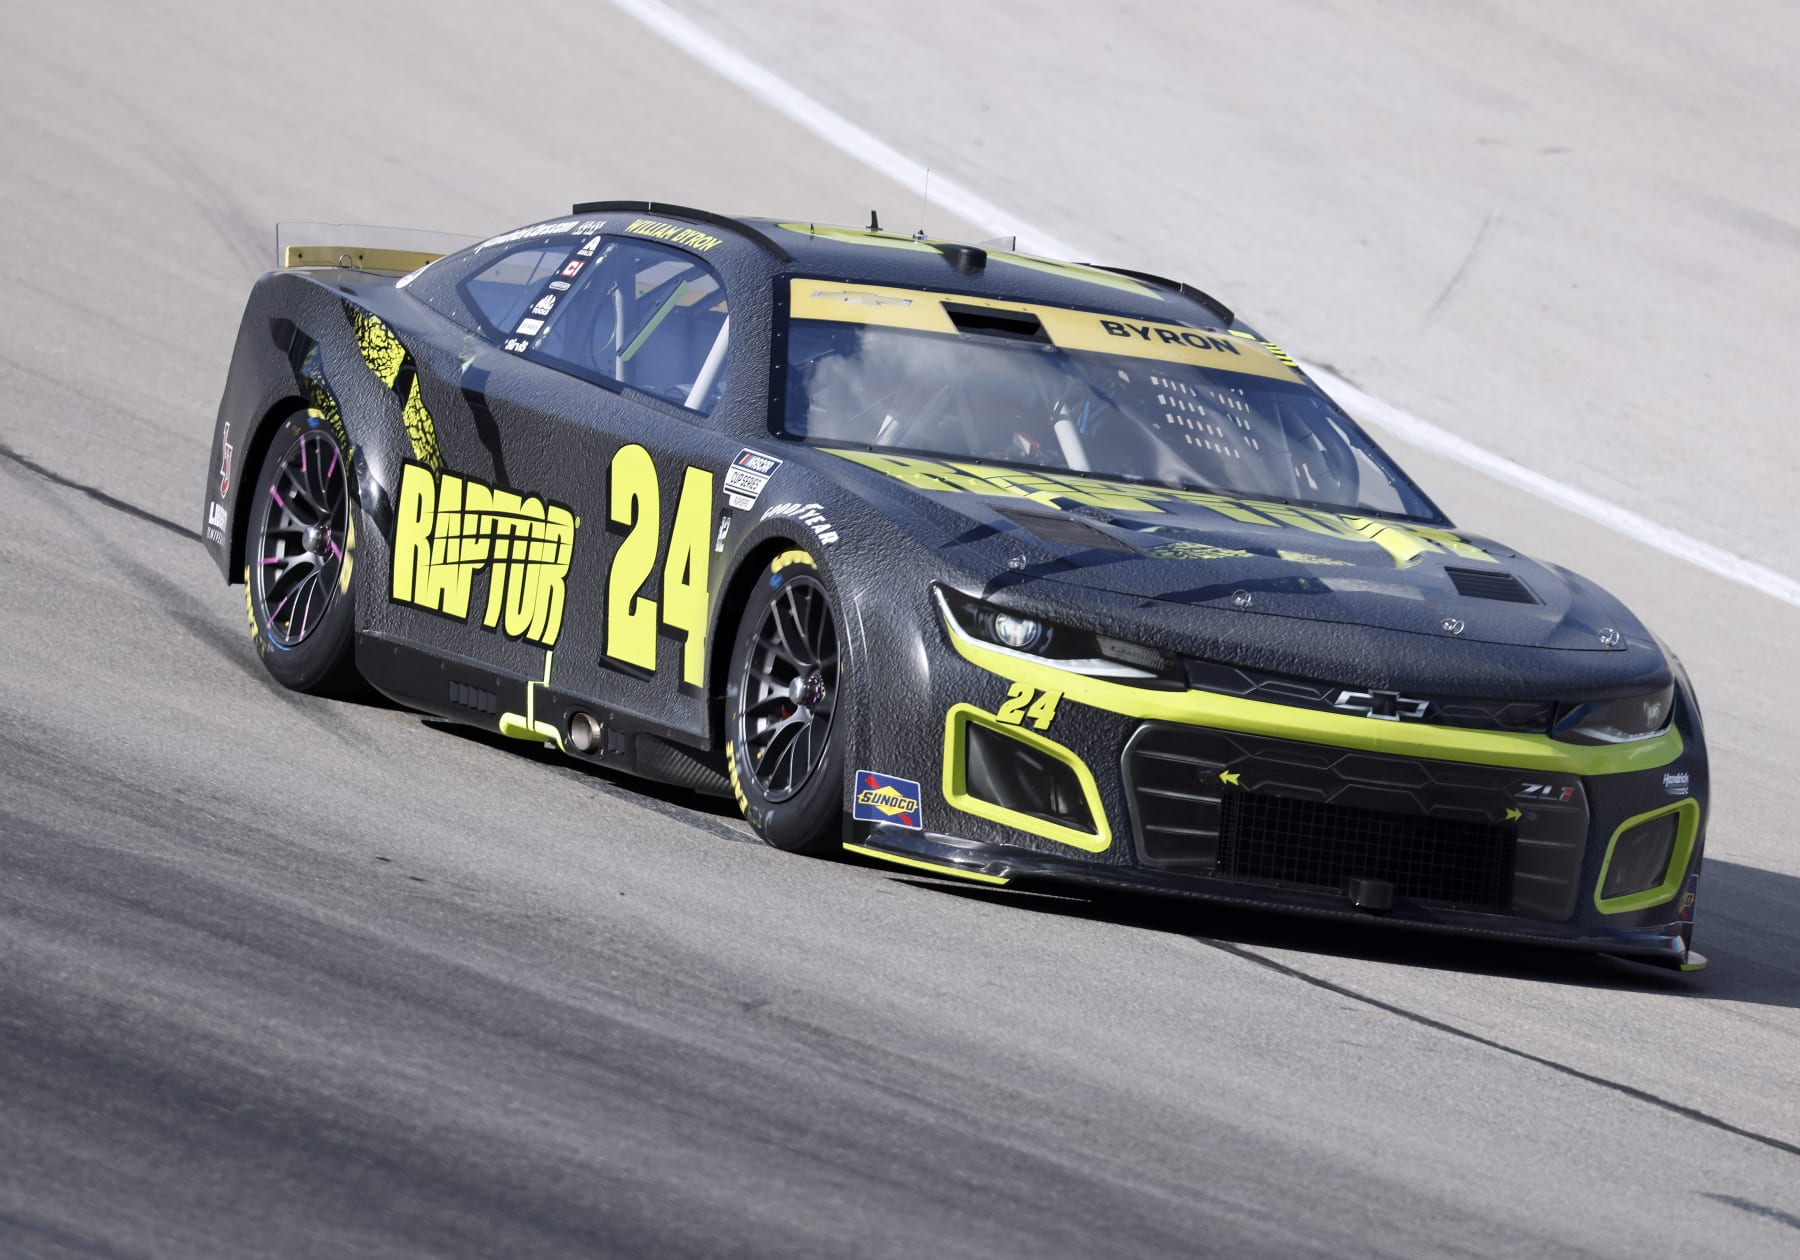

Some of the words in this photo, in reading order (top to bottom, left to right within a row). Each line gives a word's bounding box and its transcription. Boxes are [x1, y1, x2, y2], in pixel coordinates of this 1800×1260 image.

[625, 219, 683, 240] WILLIAM
[671, 228, 723, 252] BYRON
[1099, 319, 1242, 356] BYRON
[392, 462, 576, 646] RAPTOR
[606, 443, 714, 689] 24
[996, 682, 1064, 730] 24
[859, 790, 918, 813] SUNOCO
[1514, 782, 1575, 802] ZL1
